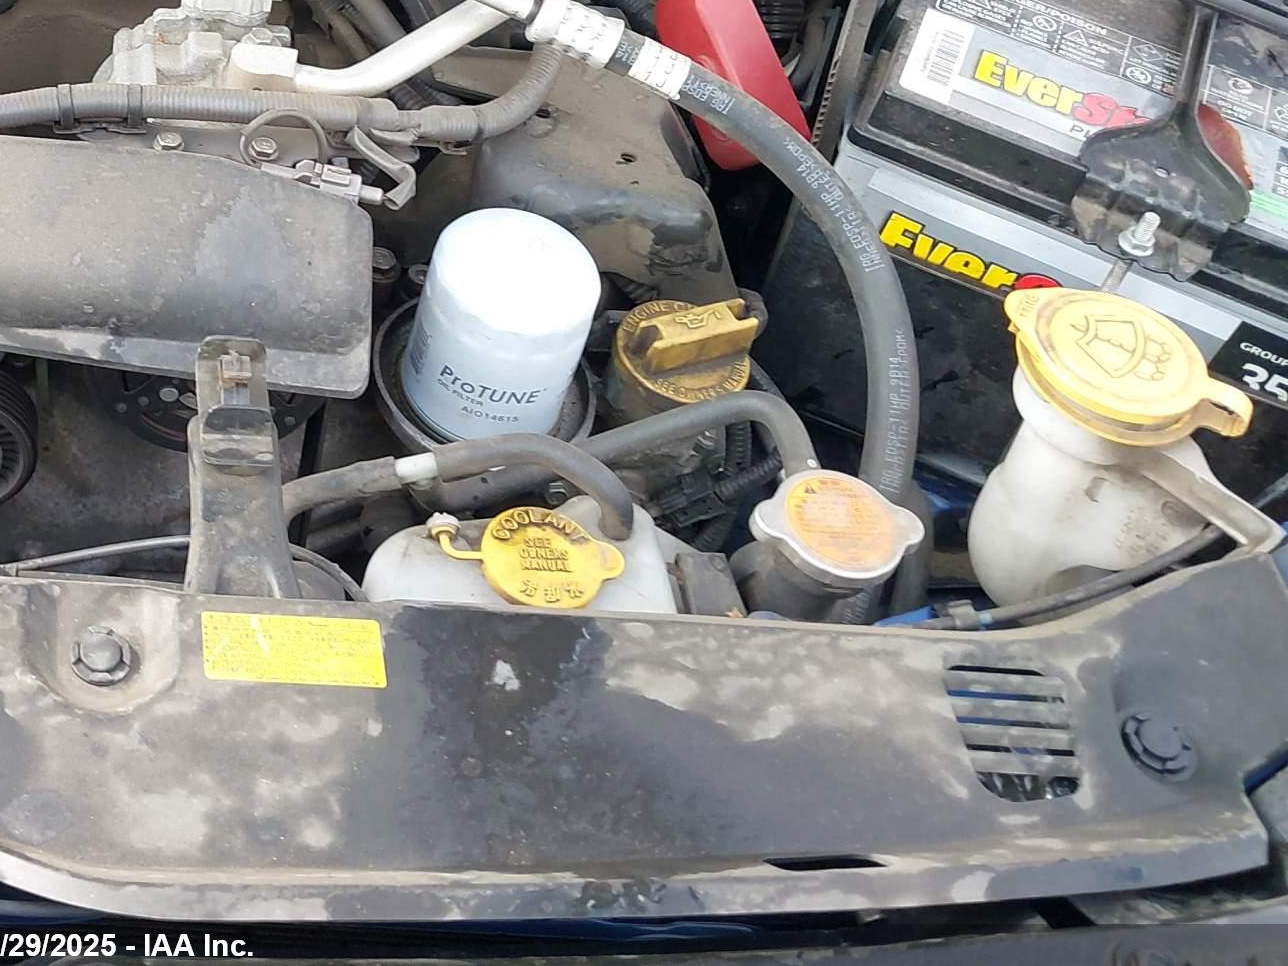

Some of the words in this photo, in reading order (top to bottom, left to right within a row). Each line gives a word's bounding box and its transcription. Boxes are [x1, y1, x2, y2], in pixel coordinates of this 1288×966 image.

[622, 302, 670, 333] ENGINE
[439, 365, 541, 405] ProTUNE
[492, 509, 586, 541] COOLANT
[524, 537, 552, 548] SEE
[520, 560, 573, 573] MANUAL
